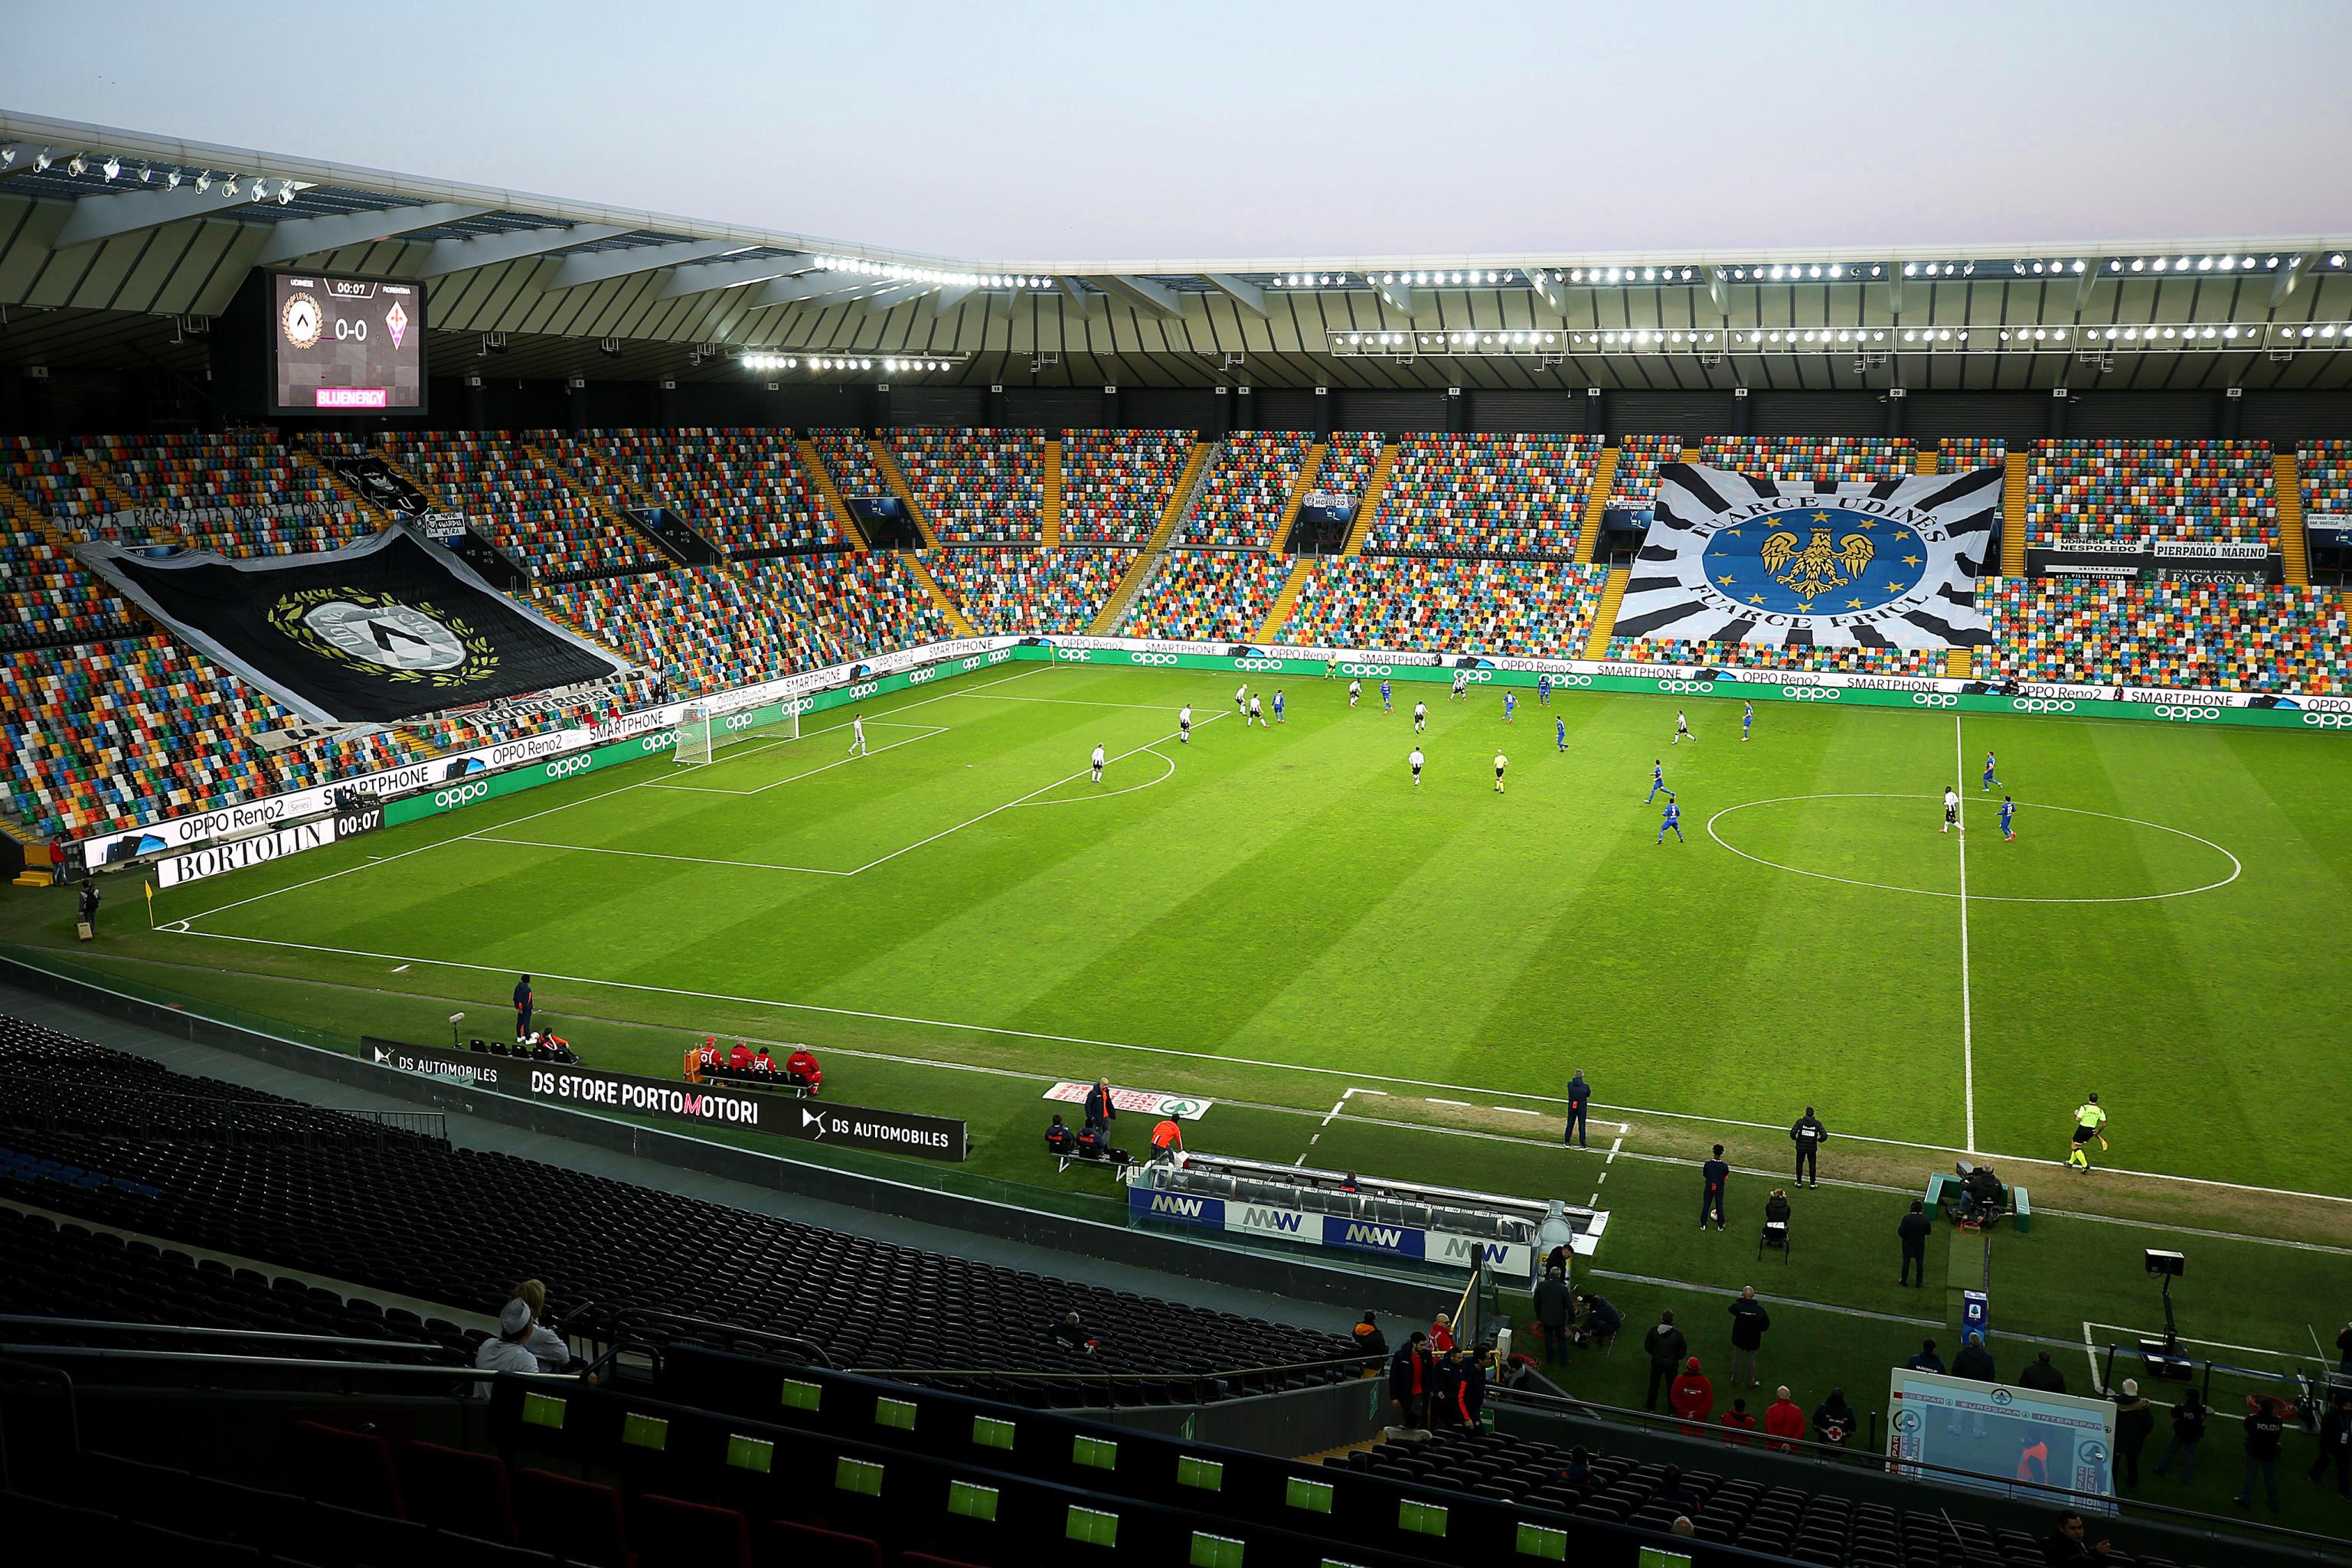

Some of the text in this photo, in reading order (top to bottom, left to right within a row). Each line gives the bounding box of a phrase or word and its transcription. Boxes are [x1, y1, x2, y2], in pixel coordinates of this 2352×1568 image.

[290, 279, 315, 288] UDINESE
[337, 282, 366, 295] 00:07
[382, 286, 411, 295] FIORENTINA
[335, 318, 368, 341] 0-0
[318, 390, 384, 405] BLUENERGY
[1692, 496, 1946, 544] FUARCE UDINÊS
[2157, 546, 2265, 558] PIERPAOLO MARINO
[2173, 573, 2246, 583] FAGAGNA
[1688, 583, 1813, 629] FUARCE
[874, 639, 994, 671] OPPO Reno2 SMARTPHONE
[988, 648, 1011, 665] oppo
[1062, 638, 1217, 655] OPPO Reno2 SMARTPHONE
[1271, 648, 1300, 659] OPPO
[1359, 653, 1438, 665] SMARTPHON
[1132, 652, 1178, 666] oppo
[1234, 657, 1283, 672] oppo
[1501, 659, 1681, 679] OPPO Reno2 SMARTPHONE
[786, 668, 841, 692] SMARTPHONE
[909, 667, 936, 684] oppo
[1341, 662, 1392, 678] oppo
[849, 681, 878, 700] oppo
[1539, 673, 1592, 688] oppo
[1658, 679, 1714, 694] oppo
[1743, 672, 1779, 684] OPPO
[1781, 674, 1820, 687] Reno2
[1847, 677, 1939, 692] SMARTPHONE
[1782, 685, 1841, 702] oppo
[2057, 687, 2102, 700] Reno2
[2132, 691, 2233, 707] SMARTPHONE
[781, 697, 815, 717] oppo
[2013, 697, 2076, 714] oppo
[2154, 704, 2220, 722] oppo
[2308, 699, 2351, 714] OPPO
[492, 740, 525, 765] OPPO
[529, 735, 562, 756] Reno2
[590, 710, 664, 741] SMARTPHONE
[642, 728, 682, 753] oppo
[546, 753, 592, 779] oppo
[179, 766, 429, 841] OPPO Reno2 Series SARTPHONE
[435, 781, 488, 808] oppo
[338, 810, 381, 837] 00:07
[175, 822, 322, 883] BORTOLIN
[399, 1057, 498, 1083] DS AUTOMOBILES
[531, 1070, 759, 1125] DS STORE PORTOMOTORI
[832, 1118, 949, 1148] DS AUTOMOBILES
[1445, 1238, 1509, 1264] MW
[1962, 1402, 2020, 1416] EUROSPAR
[2037, 1414, 2102, 1430] INTERSPAR
